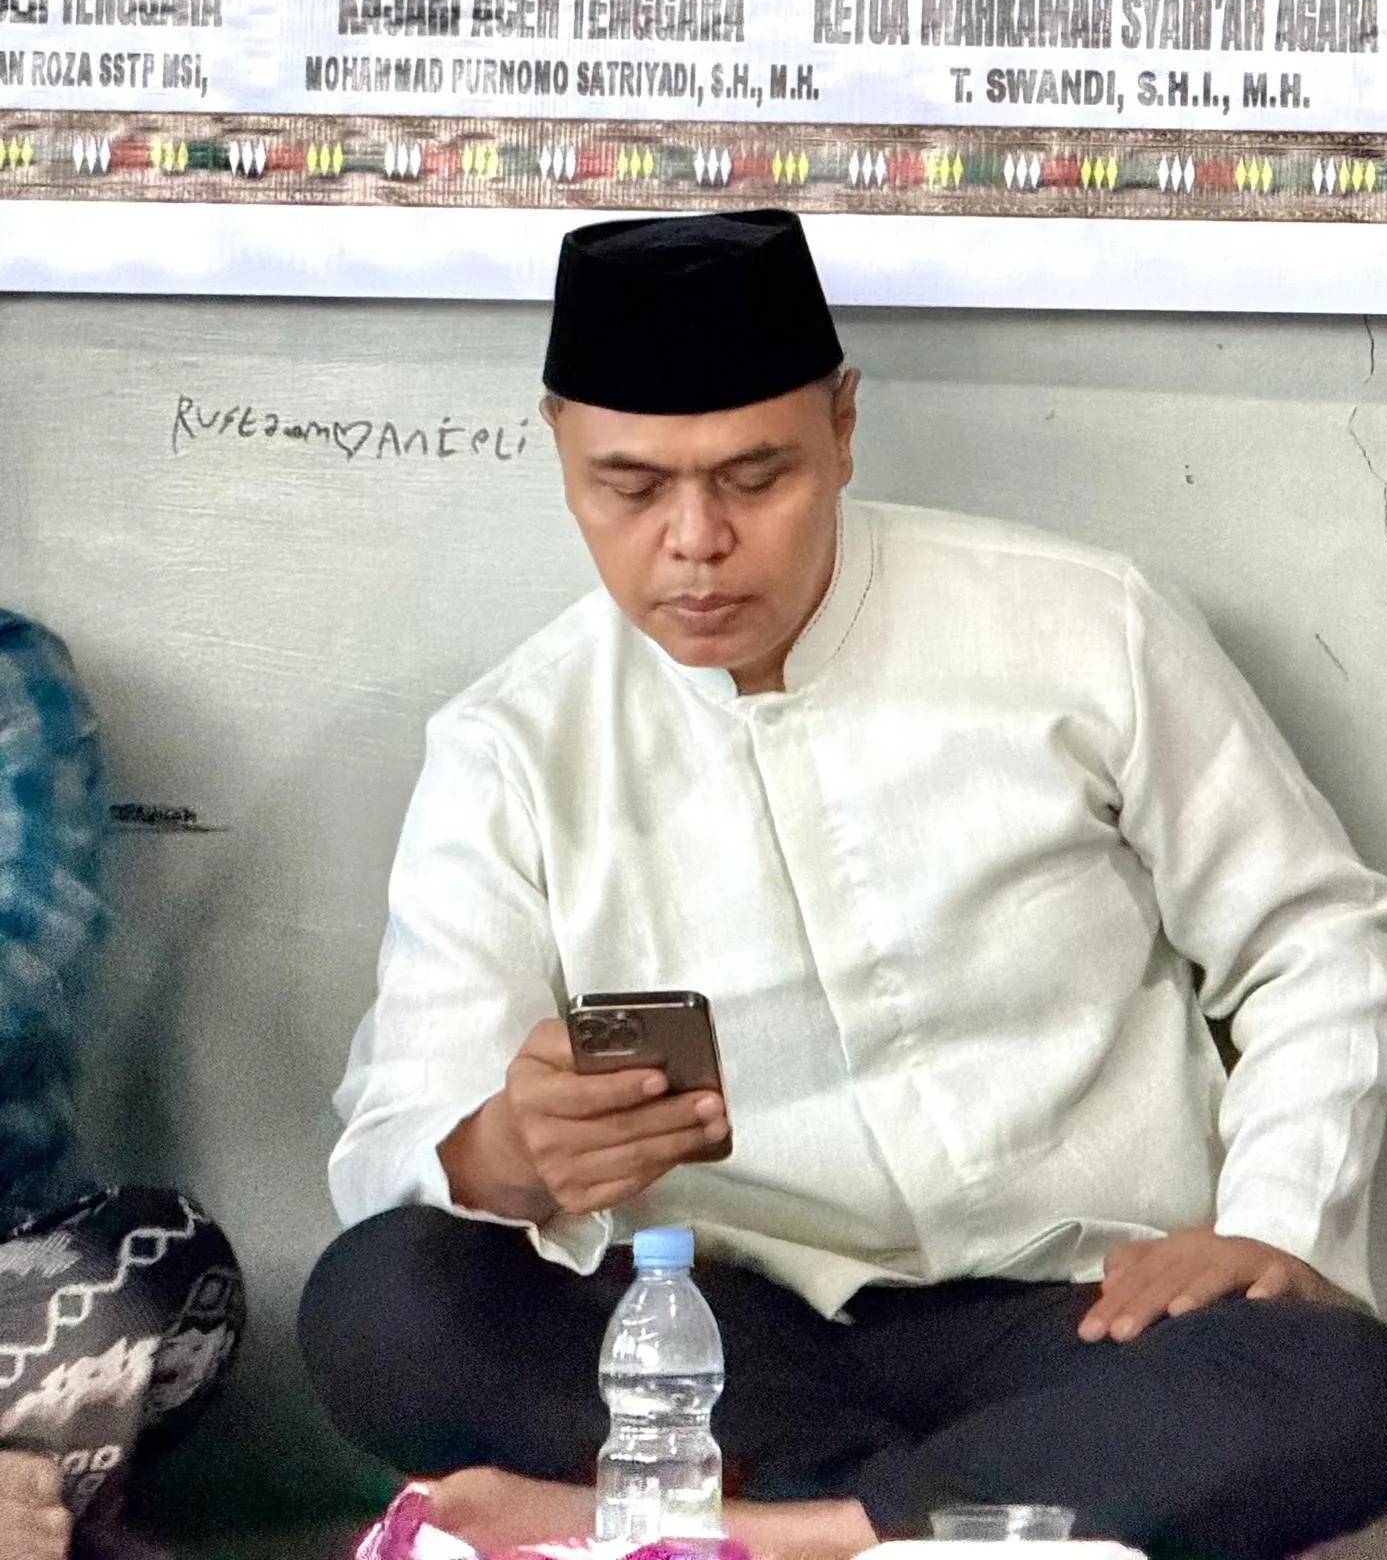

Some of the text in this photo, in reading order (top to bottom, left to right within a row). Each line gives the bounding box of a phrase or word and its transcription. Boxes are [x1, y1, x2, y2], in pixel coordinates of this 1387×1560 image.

[31, 51, 93, 87] ROZA
[100, 52, 155, 89] SSTP
[305, 55, 820, 108] MOHAMMAD PURNOMO SATRIYADI, S.H., M.H.
[949, 67, 1310, 116] T. SWANDI, S.H.I., M.H.
